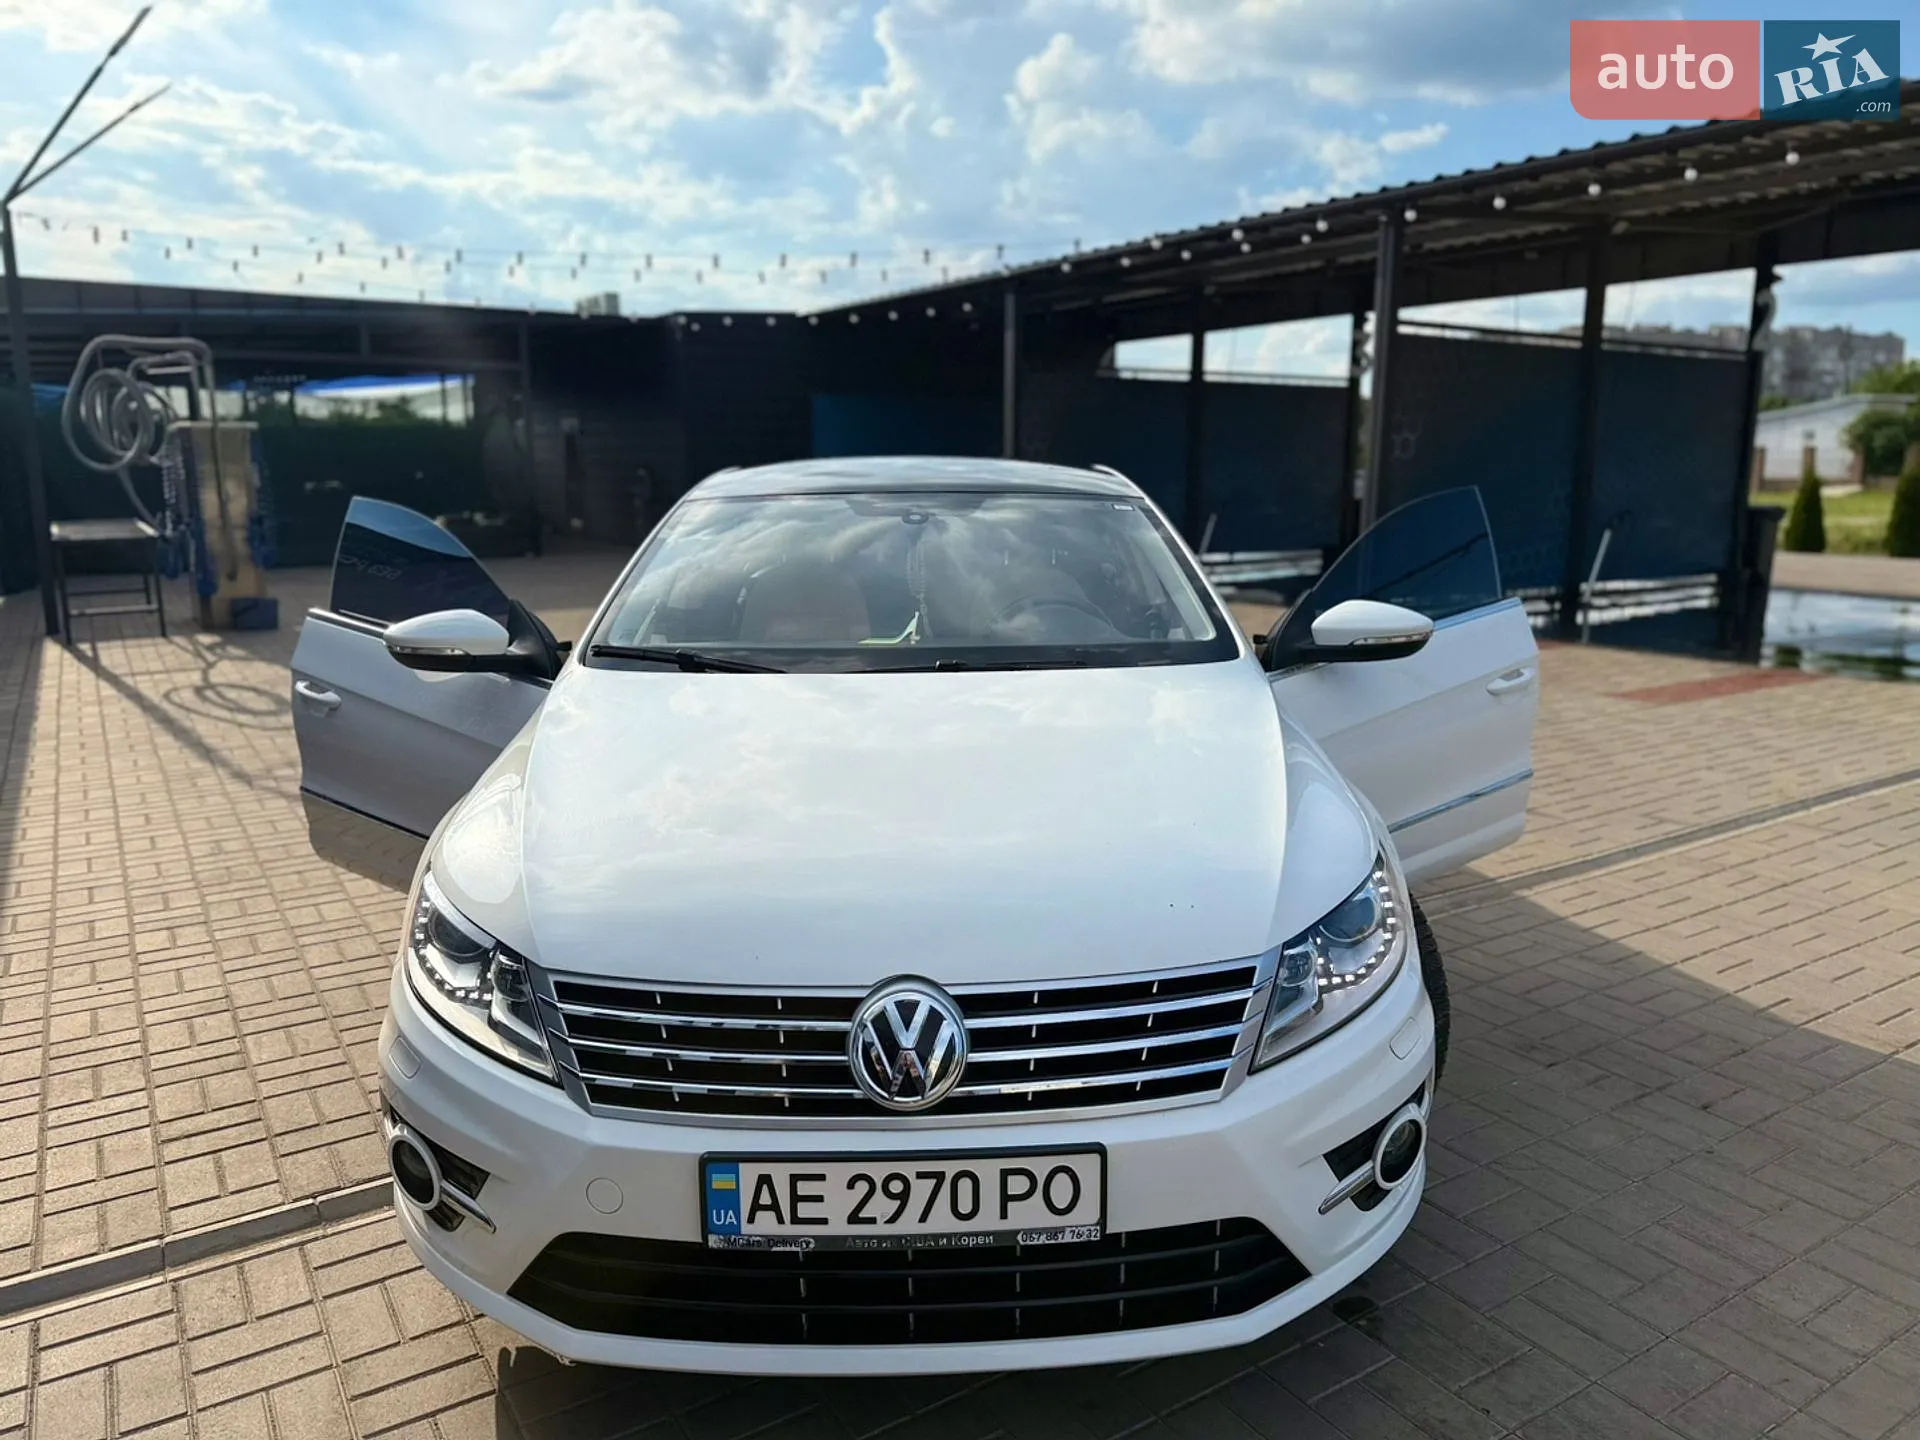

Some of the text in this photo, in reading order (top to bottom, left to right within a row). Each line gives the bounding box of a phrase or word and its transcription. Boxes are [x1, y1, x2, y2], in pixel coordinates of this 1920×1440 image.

[746, 1164, 1082, 1226] AE 2970 PO
[712, 1209, 738, 1226] UA
